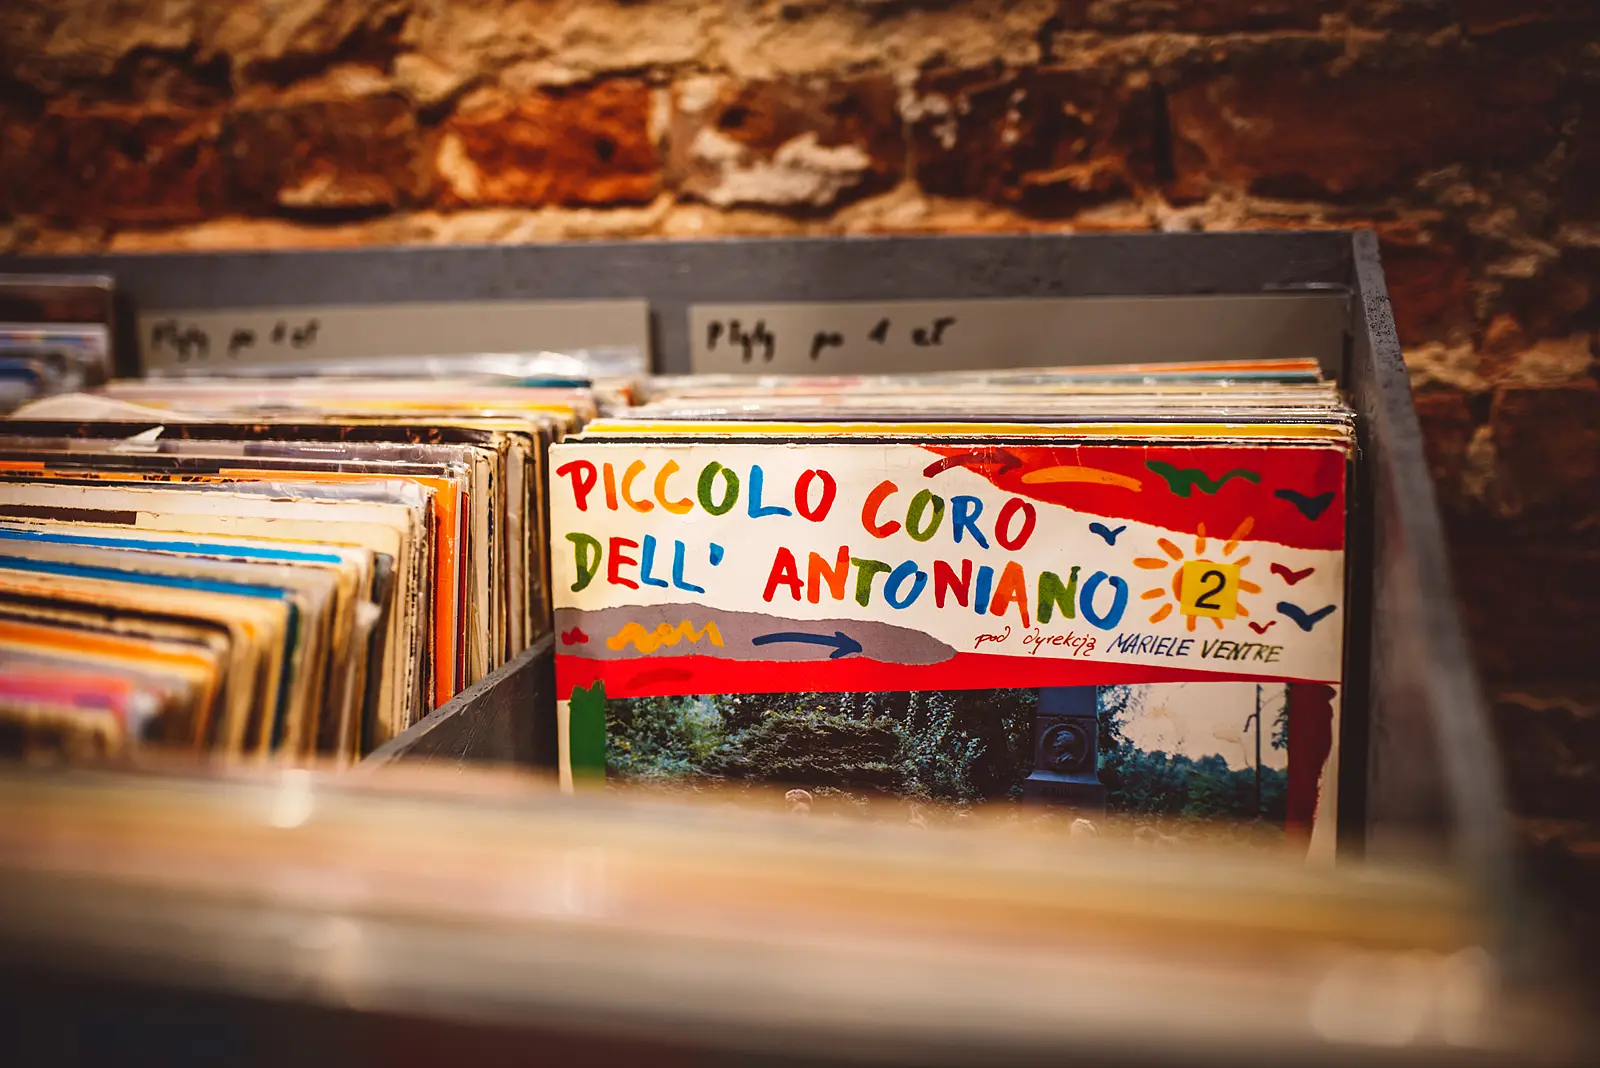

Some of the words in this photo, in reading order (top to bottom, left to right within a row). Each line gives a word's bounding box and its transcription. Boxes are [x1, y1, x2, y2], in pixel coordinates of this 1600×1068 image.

[556, 459, 837, 523] PICCOLO
[862, 480, 1036, 552] CORO
[565, 532, 725, 593] DELL'
[763, 544, 1128, 630] ANTONIANO
[1194, 570, 1226, 610] 2
[974, 626, 1010, 649] pod
[1107, 633, 1194, 657] MARIELE
[1202, 640, 1284, 662] VENTRE
